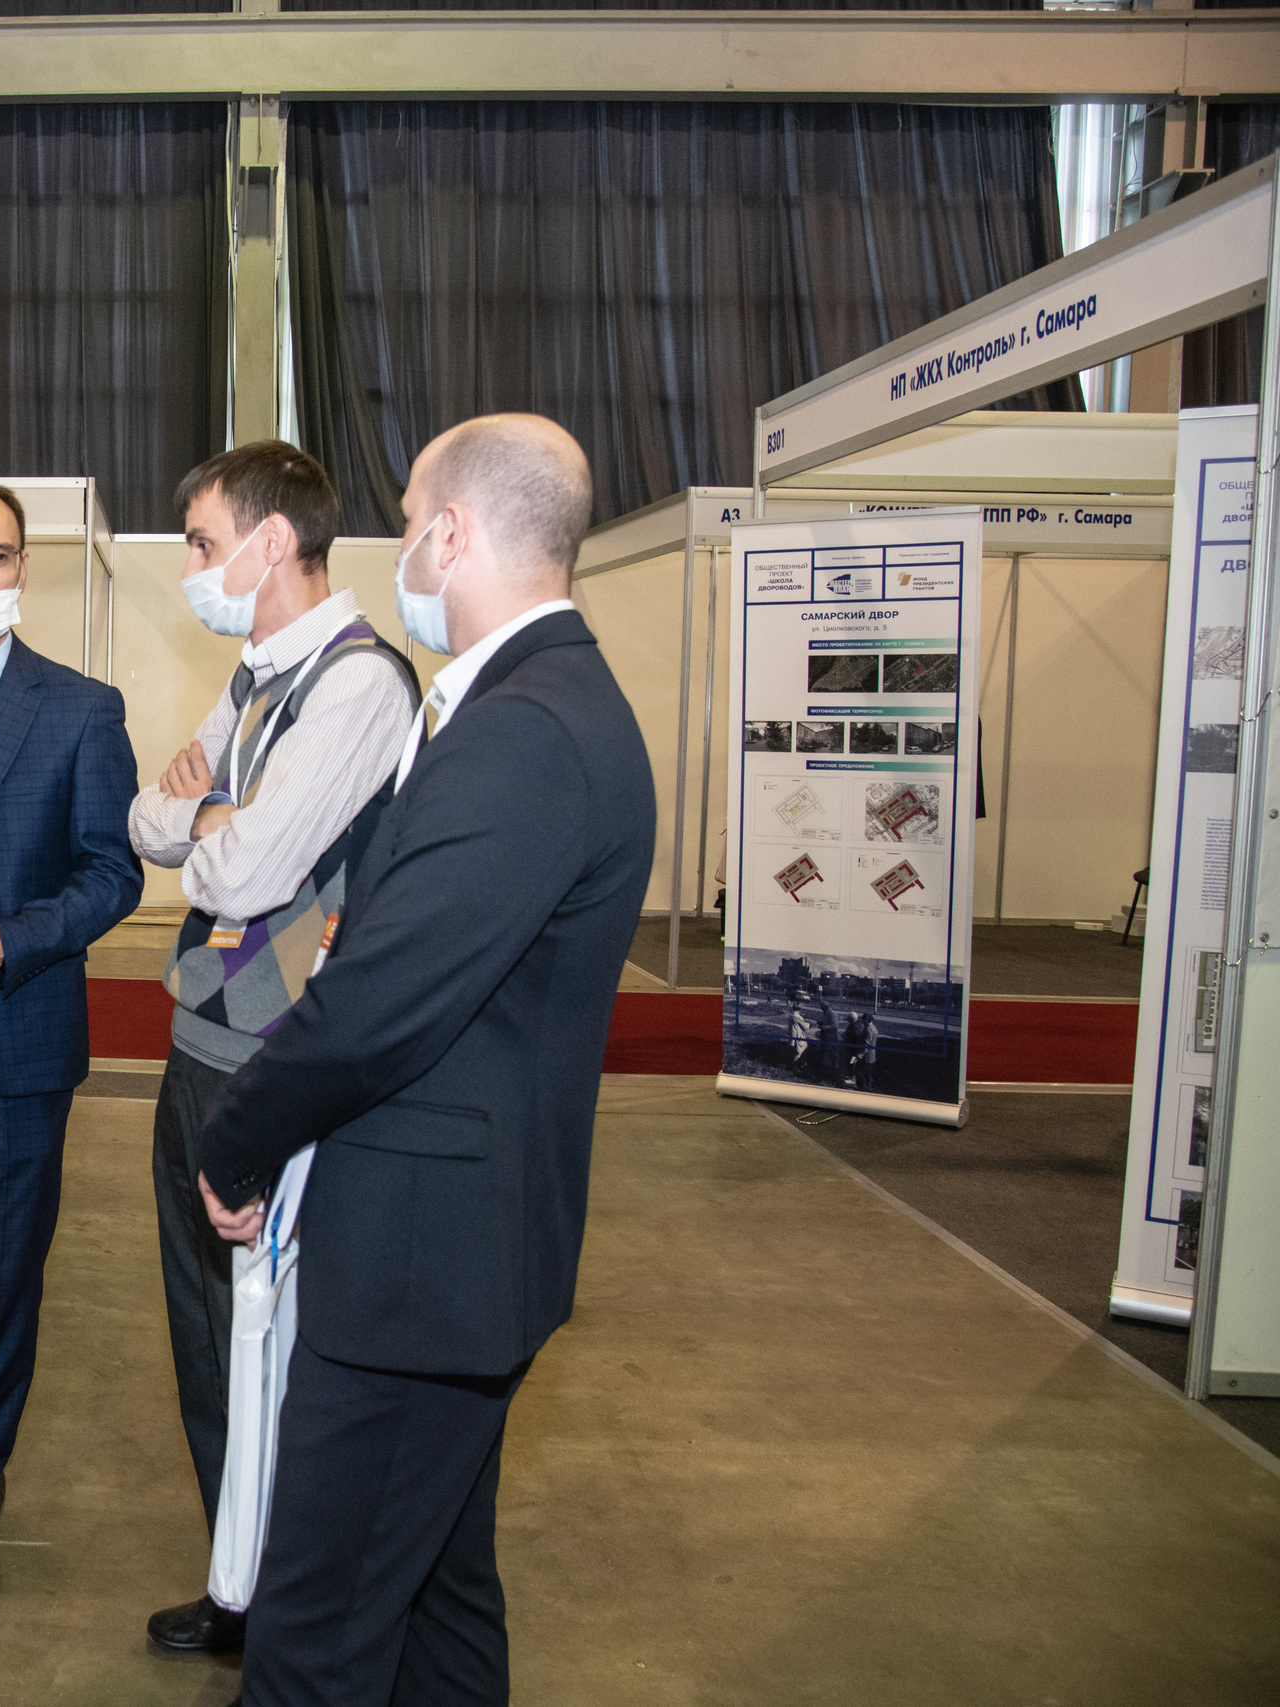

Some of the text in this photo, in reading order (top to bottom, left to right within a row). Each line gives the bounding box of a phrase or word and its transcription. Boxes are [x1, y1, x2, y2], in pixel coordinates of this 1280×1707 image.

[890, 294, 1097, 401] НП «ЖКХ Контроль» г. Самара
[1016, 507, 1048, 523] РФ»
[1058, 512, 1069, 523] г.
[1074, 508, 1133, 528] Самара
[754, 563, 809, 571] ОБЩЕСТВЕННЫЙ
[1221, 559, 1251, 573] ДВ
[801, 610, 899, 620] САМАРСКИЙ ДВОР
